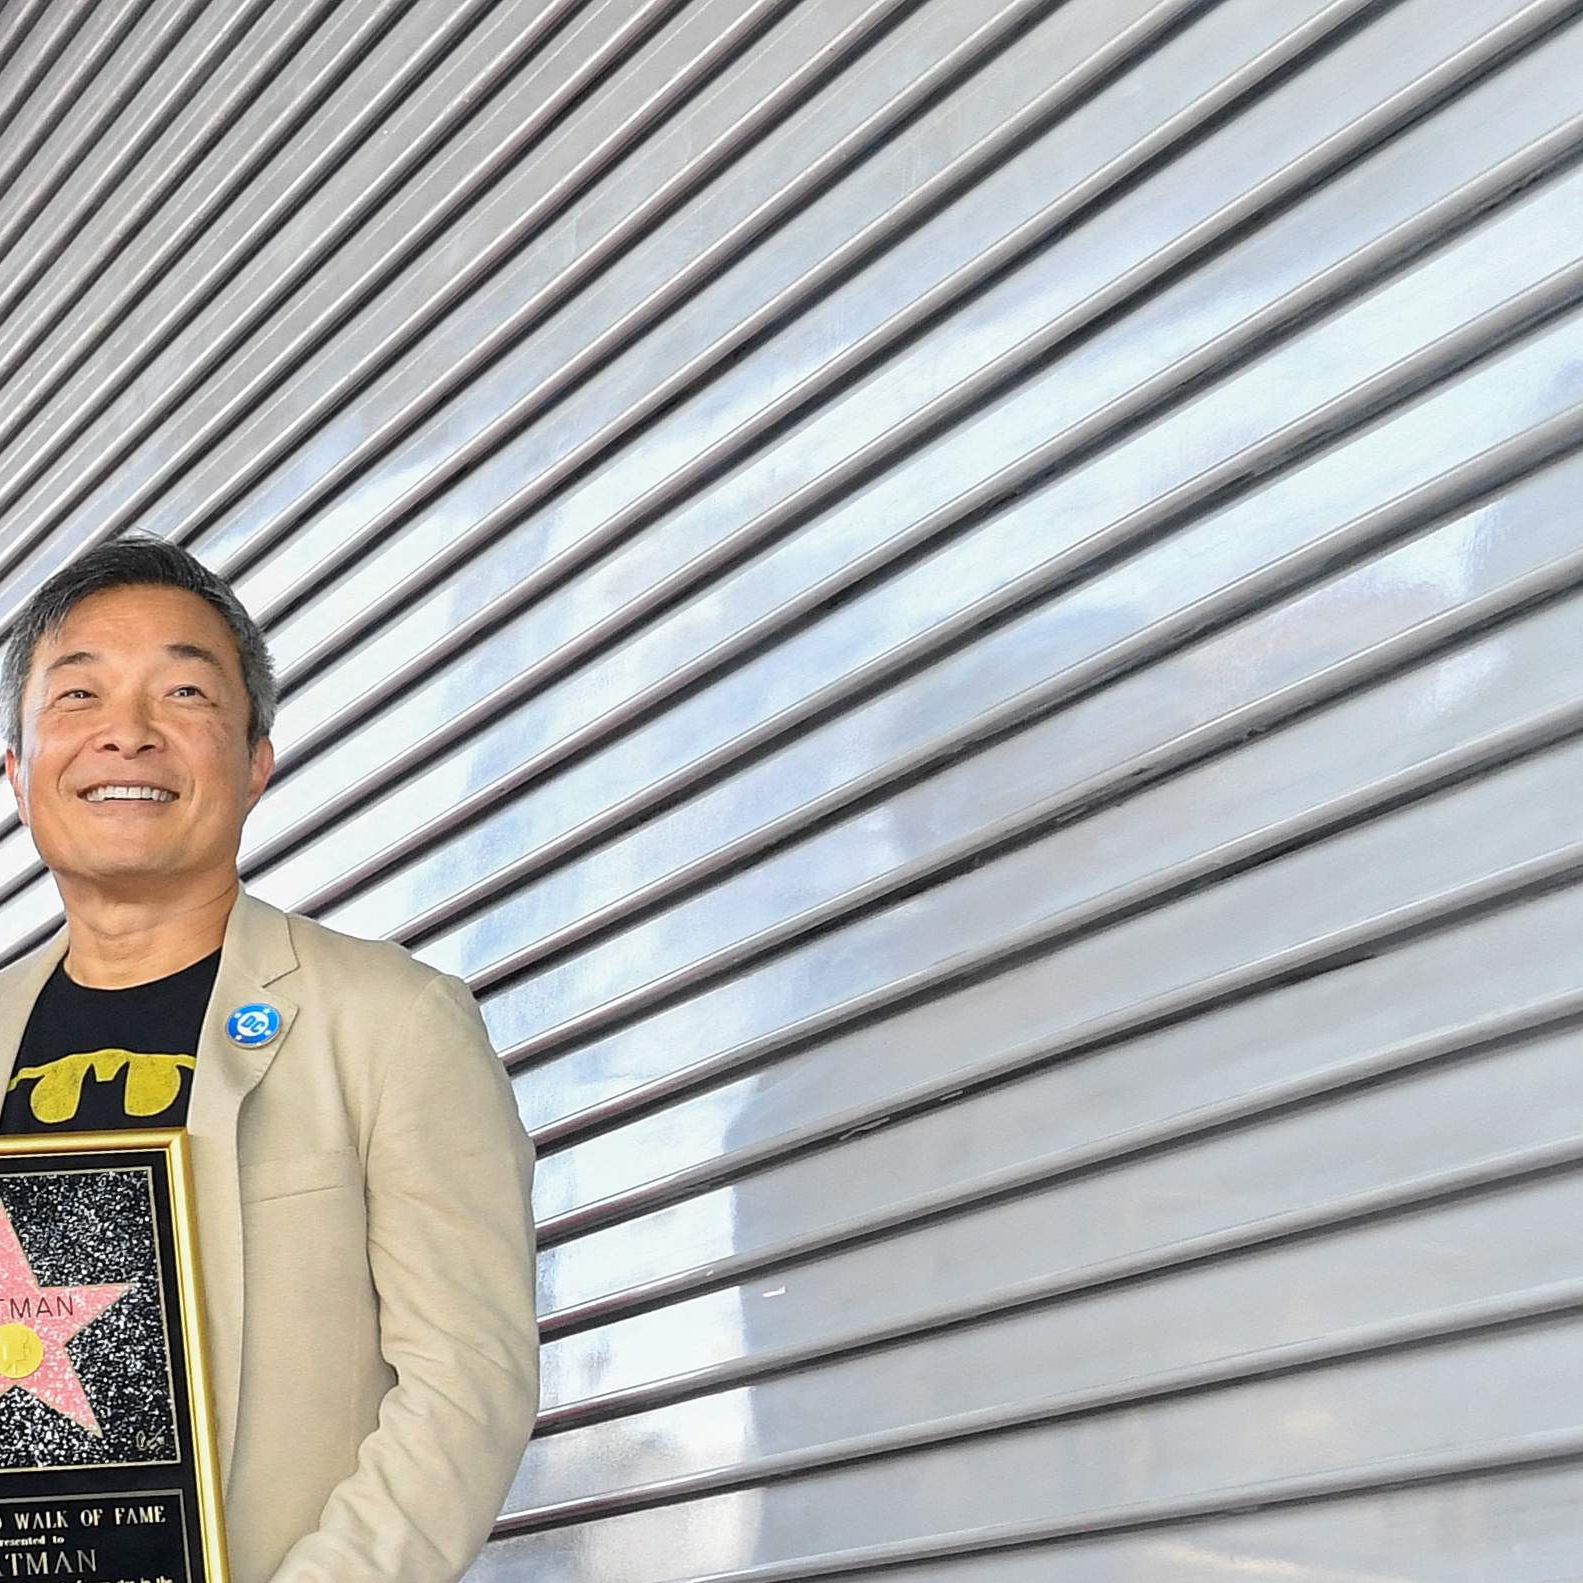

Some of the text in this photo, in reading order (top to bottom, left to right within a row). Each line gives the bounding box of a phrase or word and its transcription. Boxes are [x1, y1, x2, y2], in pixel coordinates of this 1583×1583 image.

[241, 1015, 265, 1034] DC
[14, 1510, 69, 1530] WALK
[80, 1508, 104, 1527] OF
[115, 1505, 167, 1525] FAME
[52, 1535, 65, 1545] to
